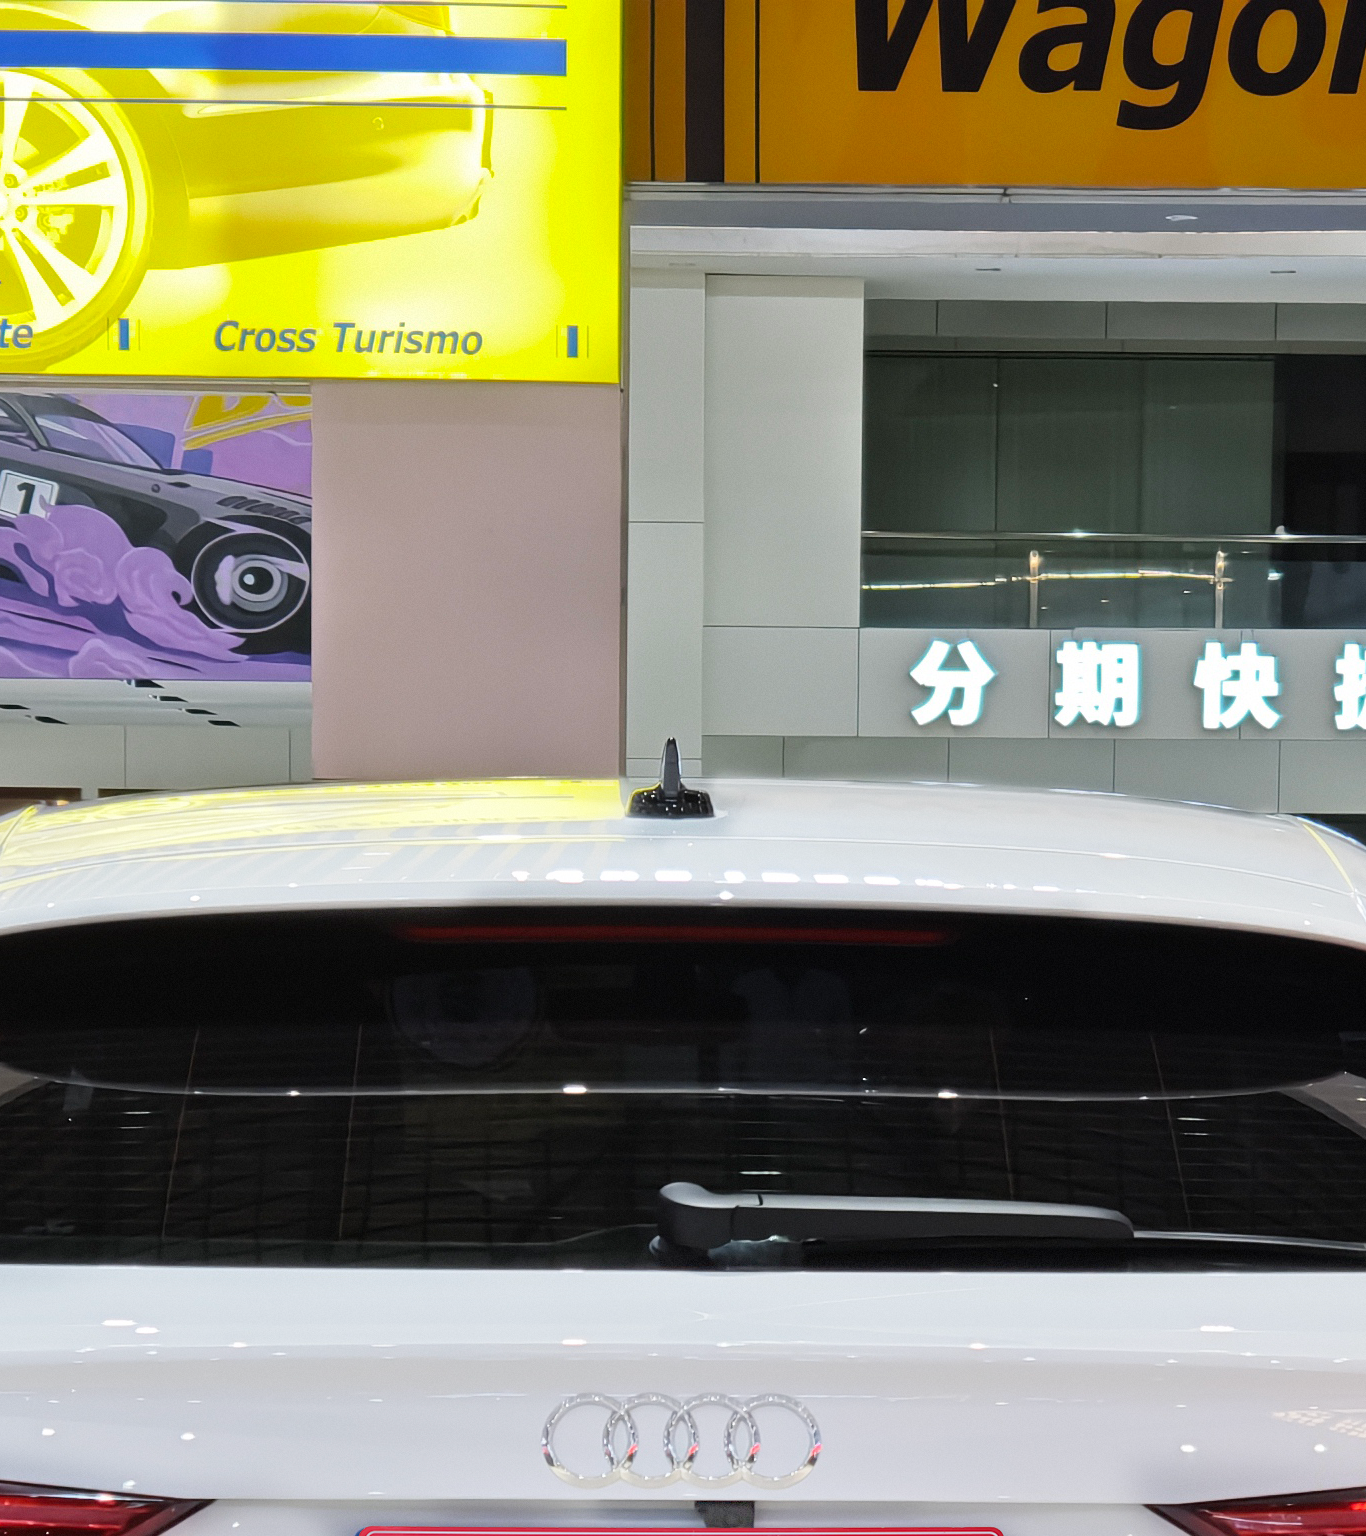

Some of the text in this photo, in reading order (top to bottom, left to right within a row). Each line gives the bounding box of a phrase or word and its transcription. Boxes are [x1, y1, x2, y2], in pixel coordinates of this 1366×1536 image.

[213, 319, 484, 356] Cross Turismo
[17, 482, 36, 515] 1
